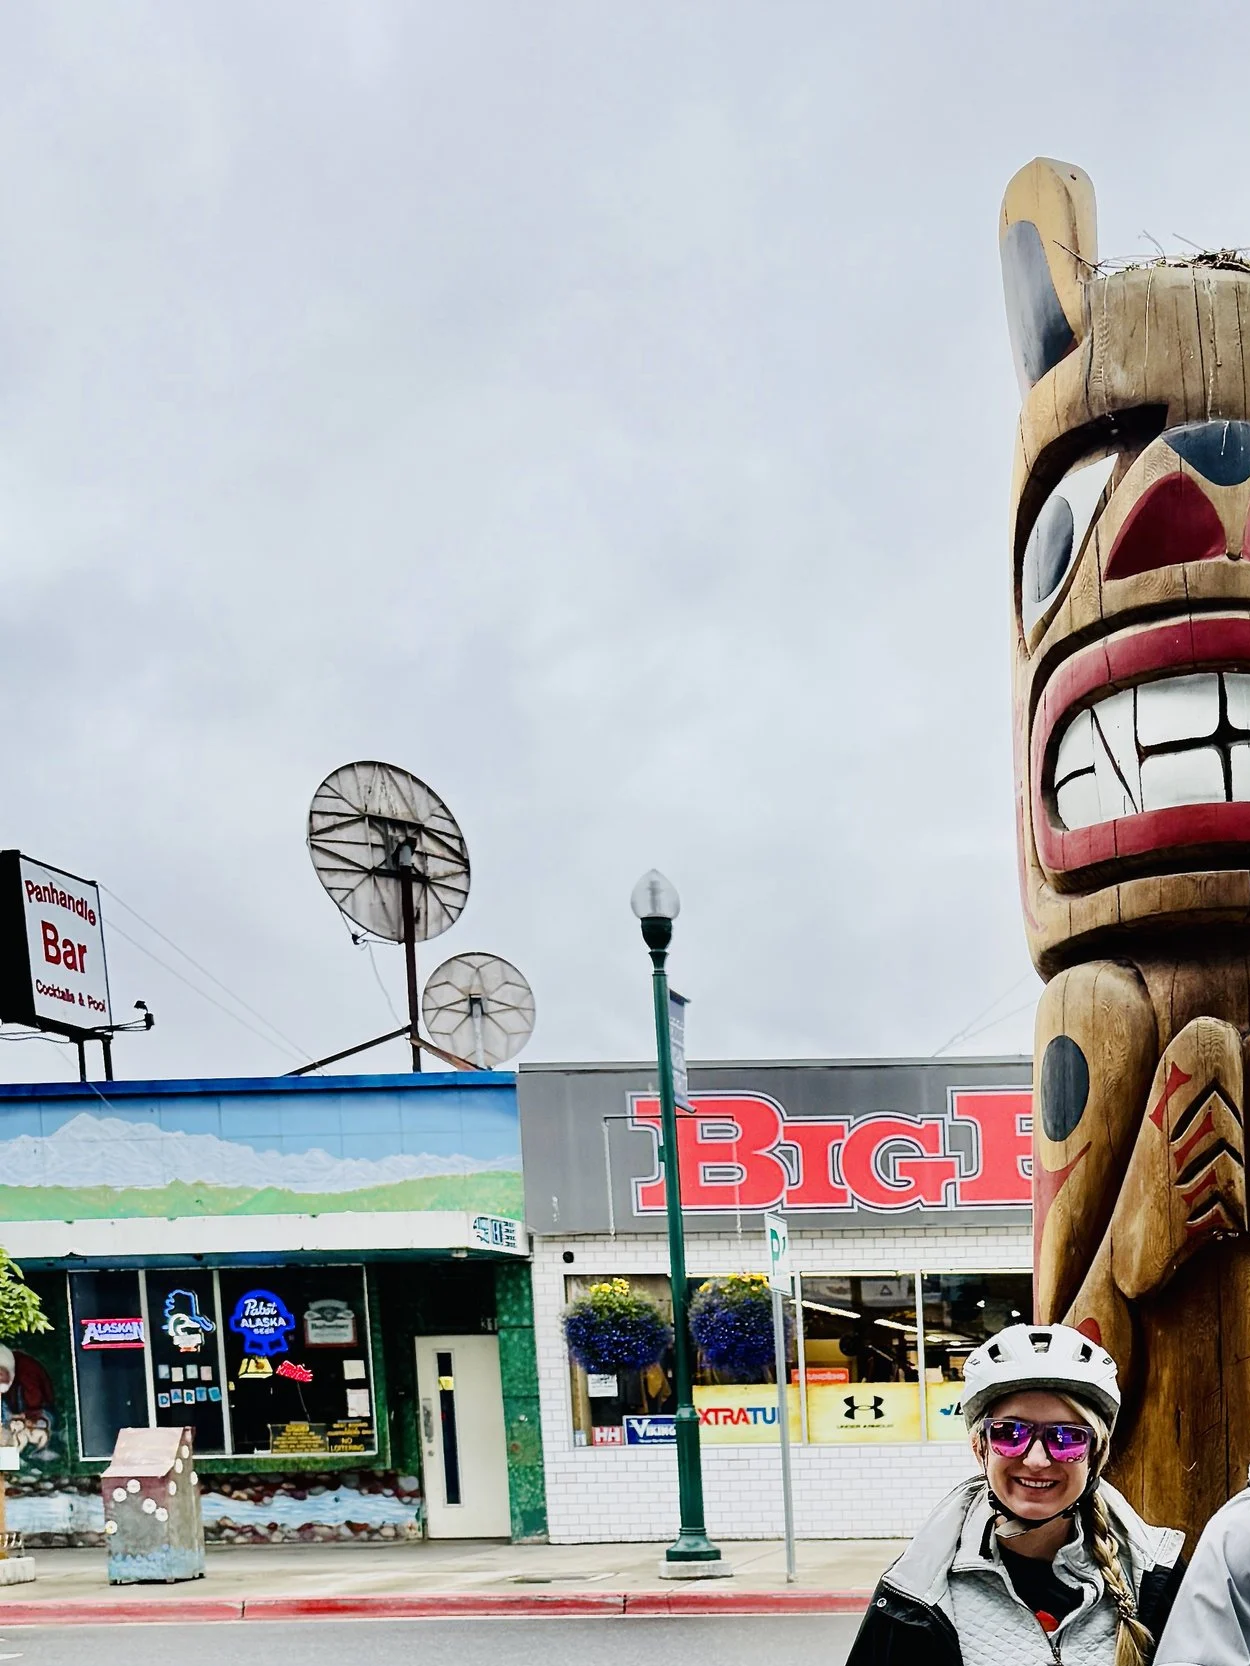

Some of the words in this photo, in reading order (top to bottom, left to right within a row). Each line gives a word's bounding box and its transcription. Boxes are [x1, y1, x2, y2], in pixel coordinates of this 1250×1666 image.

[24, 880, 96, 926] Panhandle
[41, 920, 87, 973] Bar
[35, 979, 75, 1004] Cocktails
[87, 994, 106, 1013] Pool
[244, 1298, 278, 1317] Pabst
[240, 1316, 287, 1328] ALASKA
[81, 1321, 145, 1346] ALASKAN
[698, 1407, 780, 1425] XTRATU
[595, 1426, 622, 1443] HH
